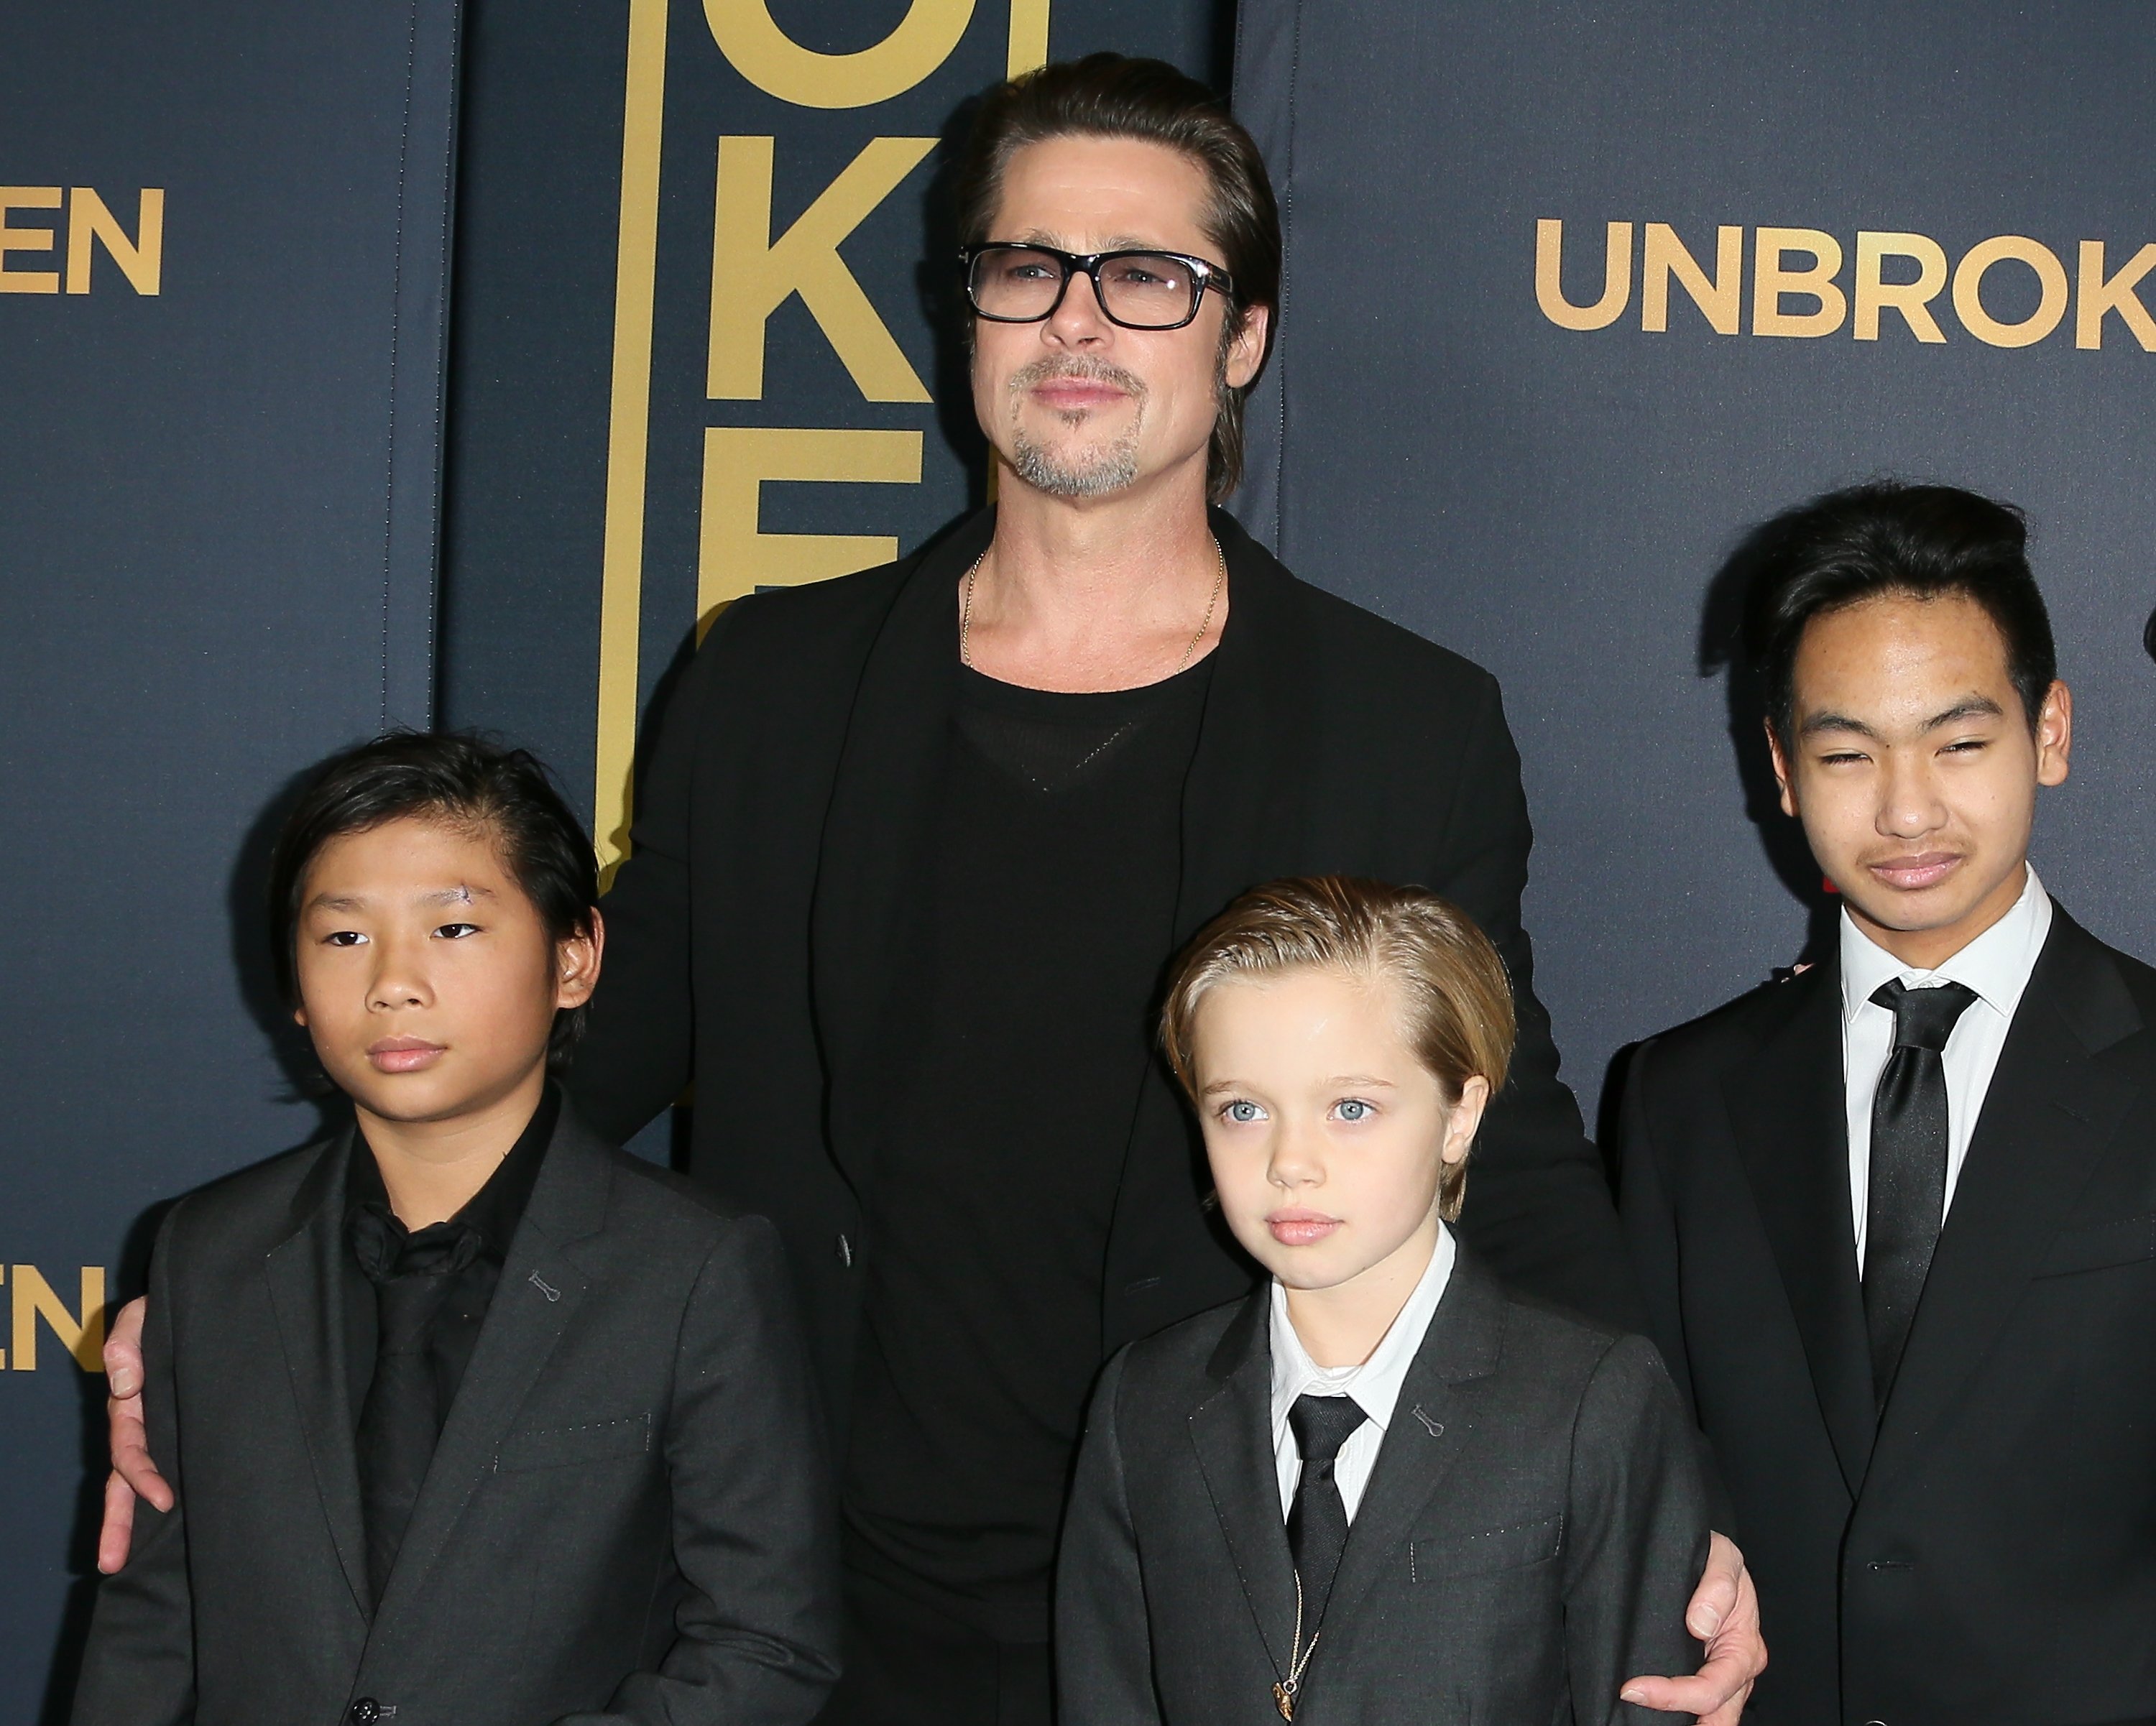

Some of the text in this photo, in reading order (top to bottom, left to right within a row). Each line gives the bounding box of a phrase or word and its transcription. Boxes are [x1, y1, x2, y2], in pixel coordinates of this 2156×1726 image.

[0, 186, 165, 295] EN
[1534, 218, 2156, 352] UNBROK
[0, 1264, 106, 1372] N
